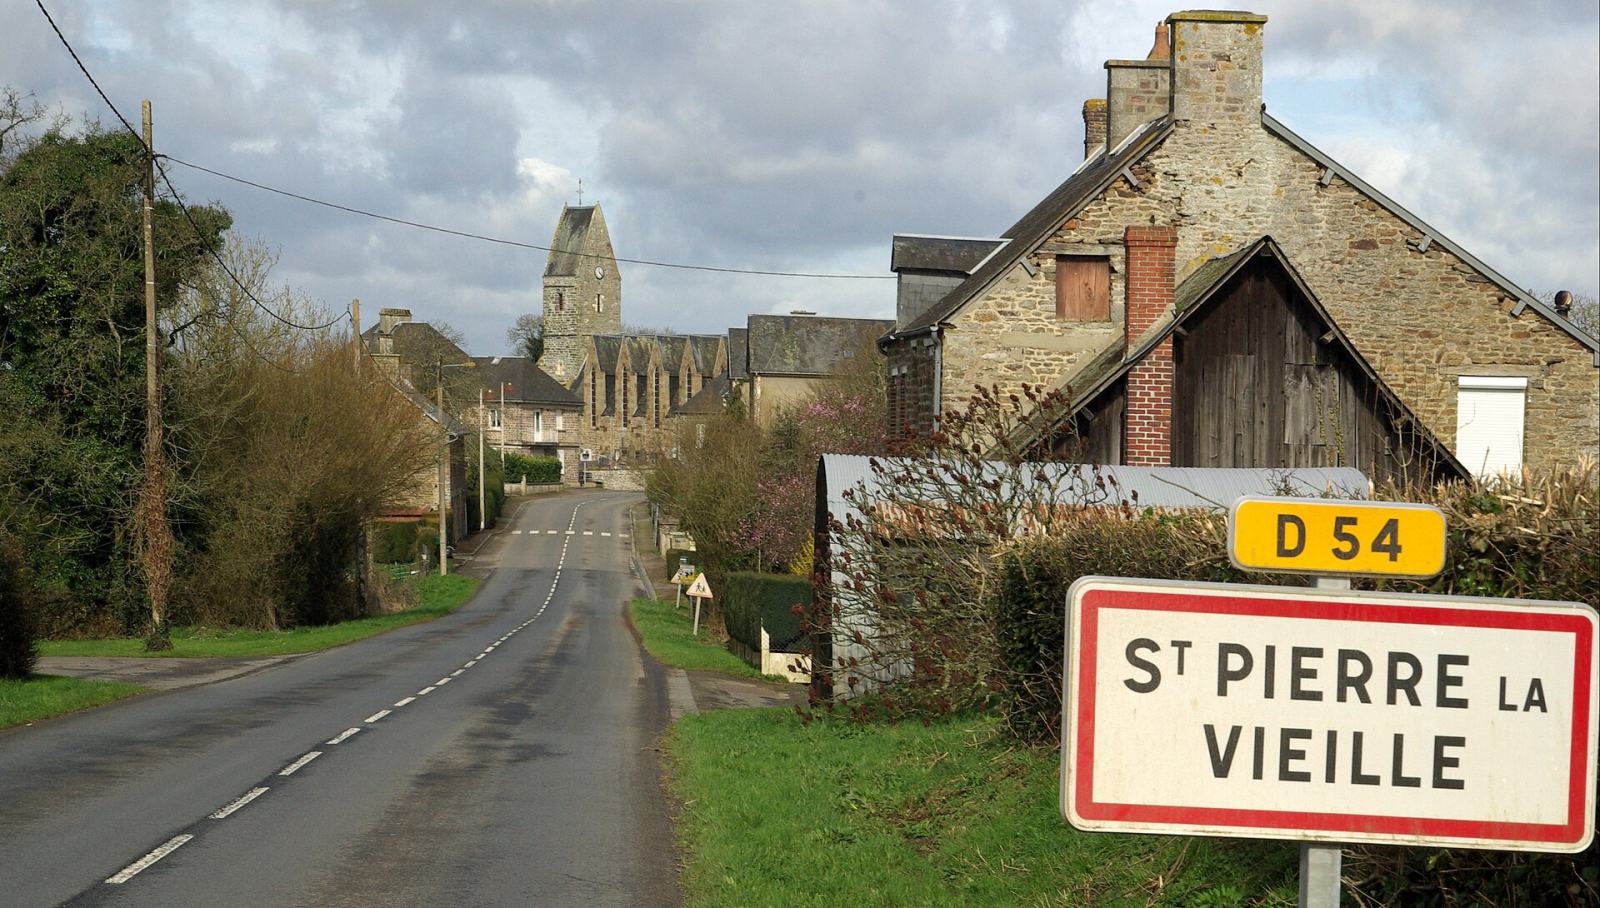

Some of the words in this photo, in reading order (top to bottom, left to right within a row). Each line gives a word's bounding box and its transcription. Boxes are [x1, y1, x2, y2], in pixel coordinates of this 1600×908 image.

[1276, 514, 1306, 558] D
[1332, 516, 1402, 562] 54
[1217, 642, 1469, 709] PIERRE
[1498, 676, 1548, 713] LA
[1203, 724, 1466, 790] VIEILLE
